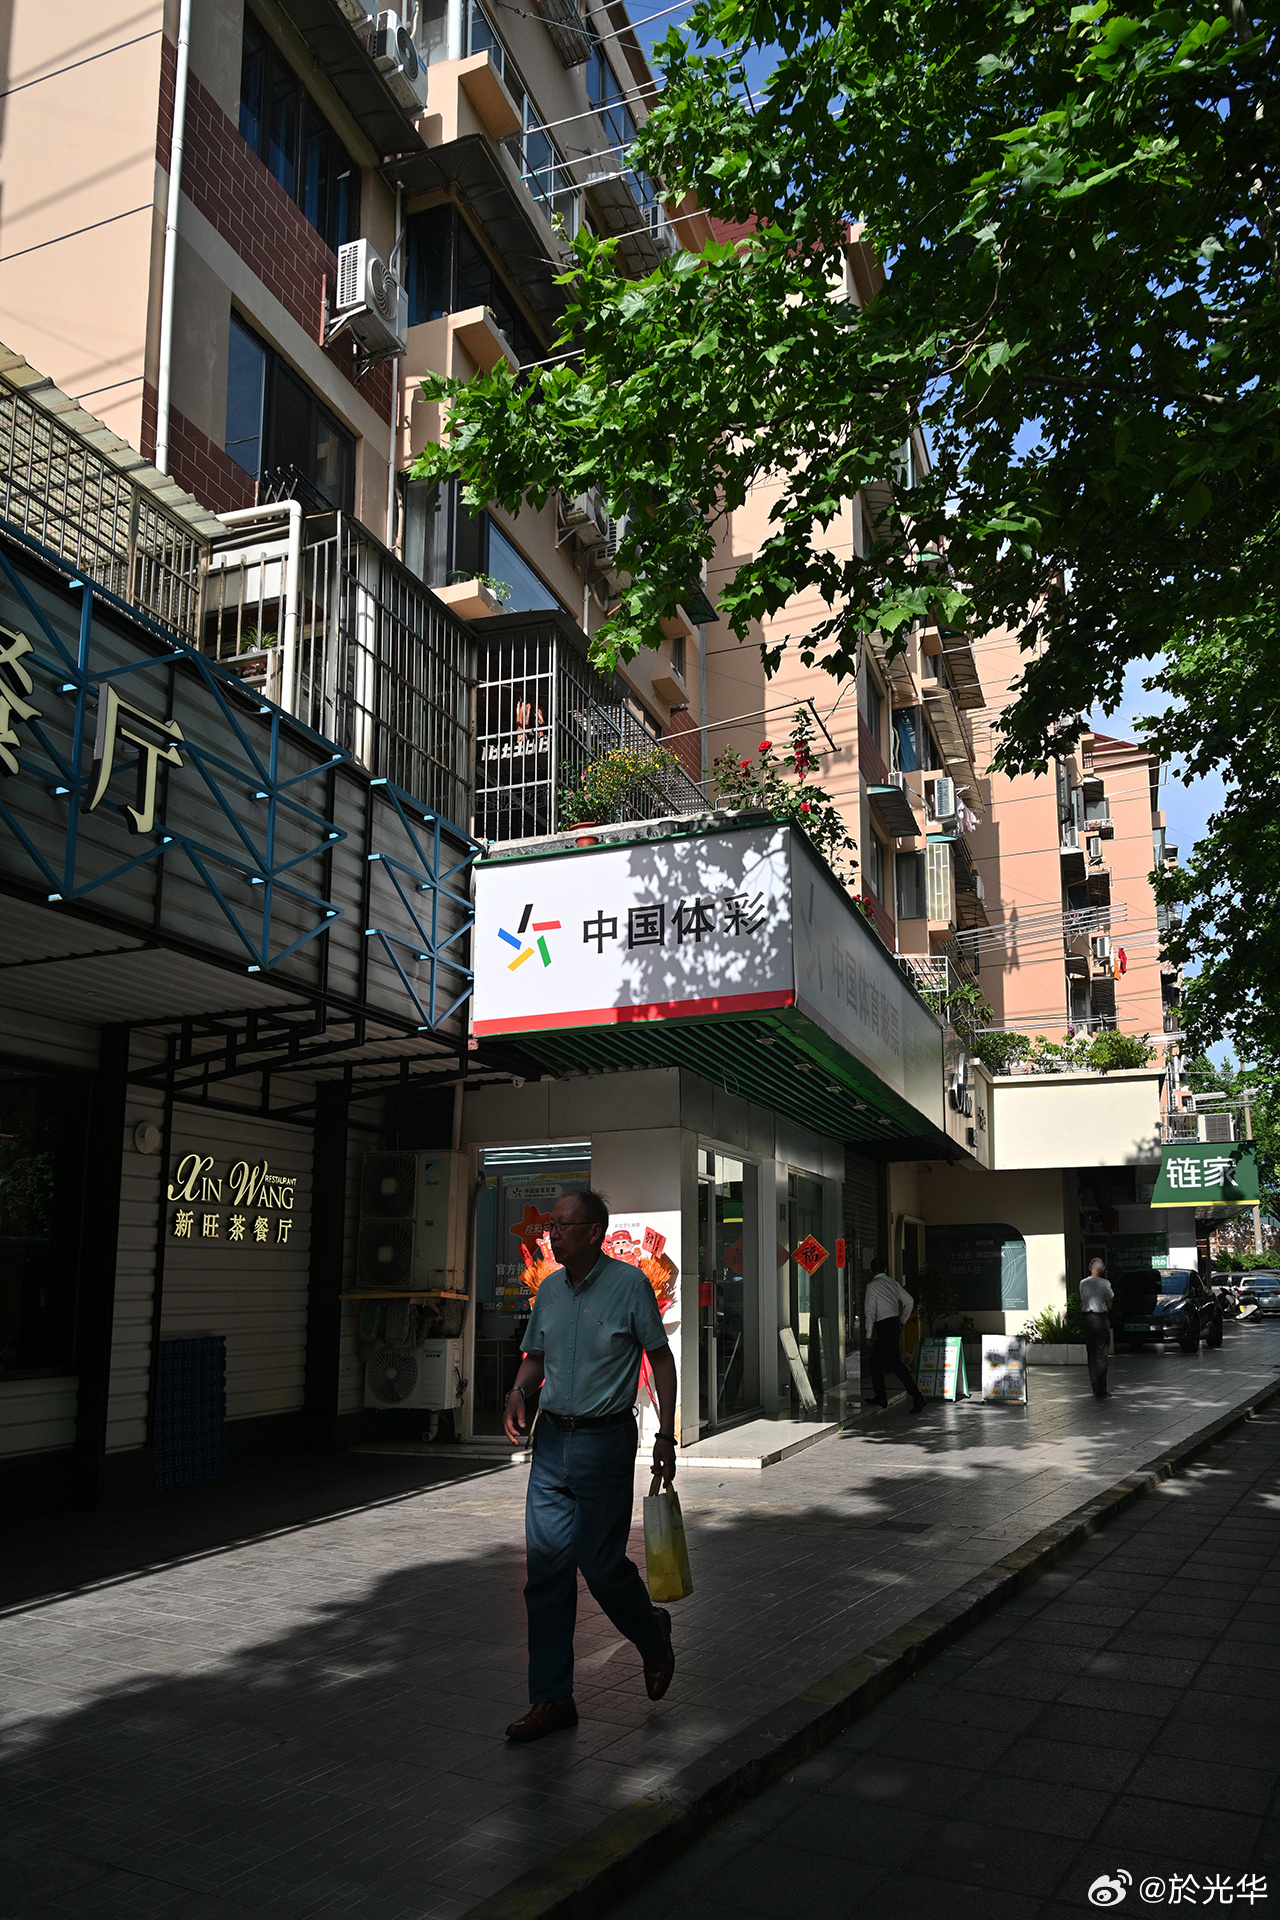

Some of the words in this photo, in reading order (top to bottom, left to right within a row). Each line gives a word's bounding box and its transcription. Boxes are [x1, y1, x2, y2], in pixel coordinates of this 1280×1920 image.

[582, 890, 767, 954] 中国体彩
[832, 936, 901, 1057] 中国体育彩票
[264, 1174, 297, 1186] RESTAURANT
[1166, 1156, 1240, 1189] 链家
[524, 1187, 557, 1195] 中国体育彩票
[174, 1208, 293, 1244] 新旺茶餐厅
[802, 1245, 819, 1264] 福
